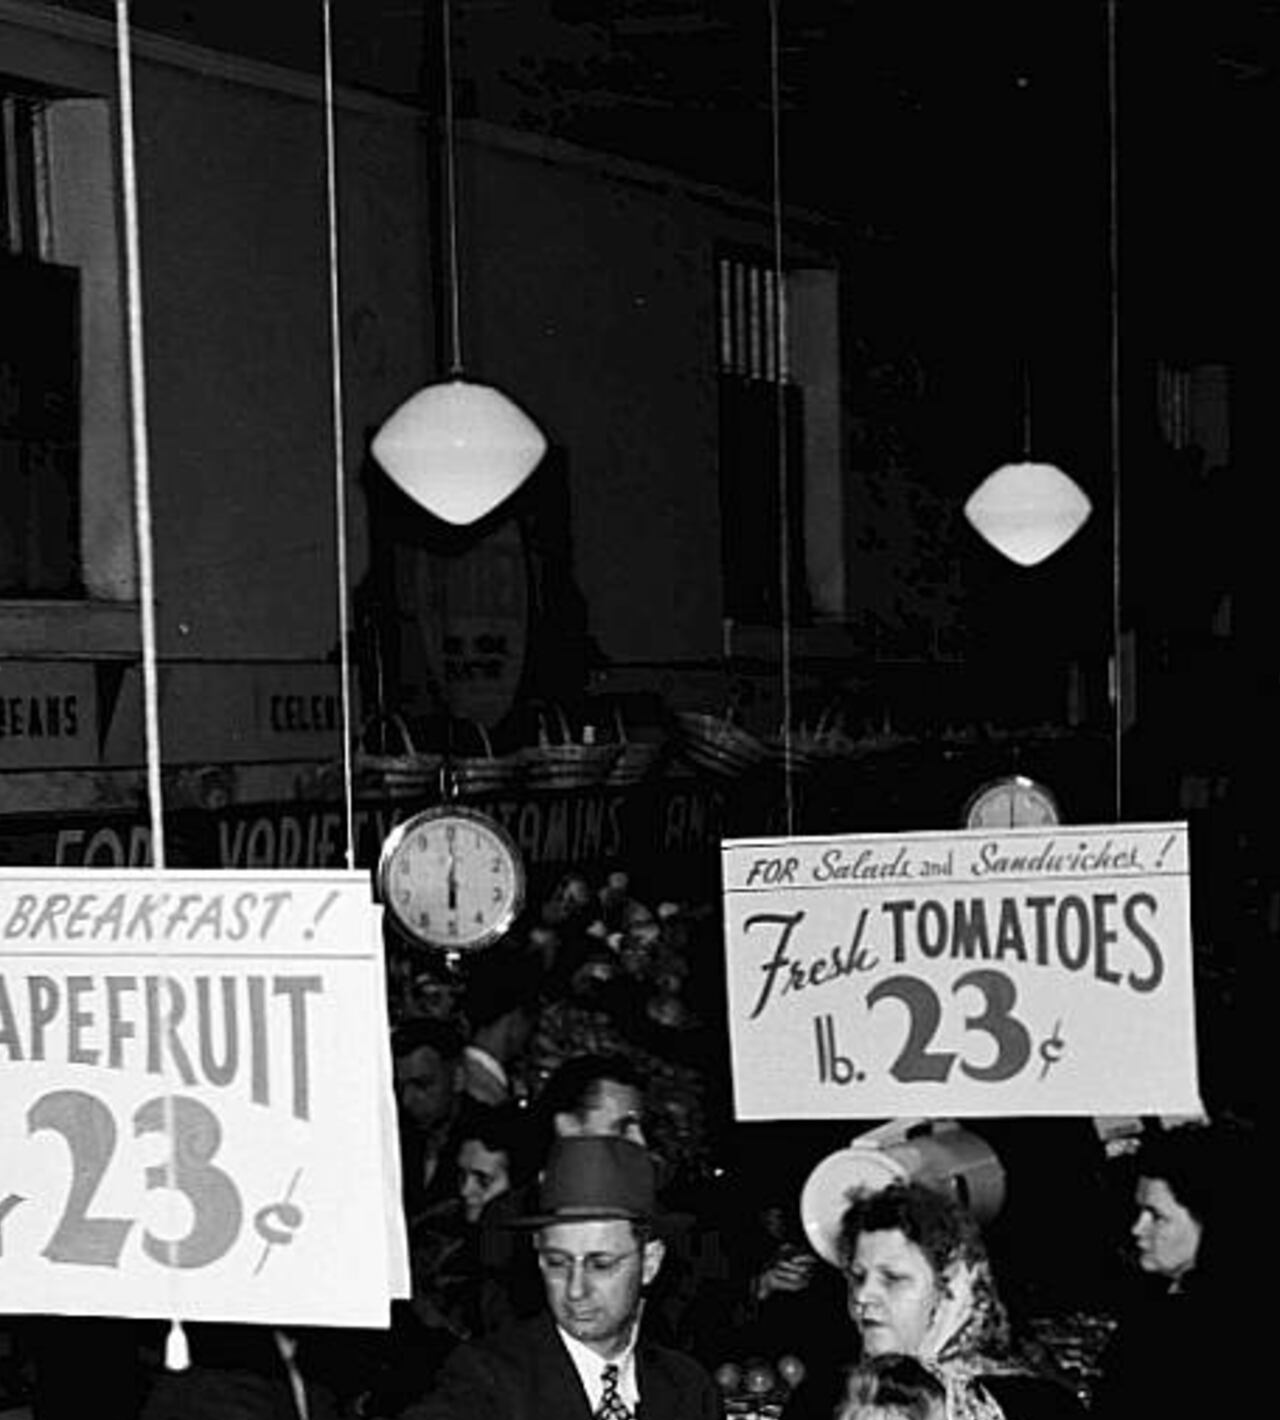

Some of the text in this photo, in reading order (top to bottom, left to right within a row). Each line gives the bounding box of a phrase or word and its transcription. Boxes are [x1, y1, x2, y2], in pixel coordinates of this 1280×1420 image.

[746, 859, 799, 885] FOR
[813, 847, 915, 882] Salads
[920, 850, 954, 877] and
[743, 892, 1164, 1020] Fresh TOMATOES
[814, 1014, 866, 1085] lb.
